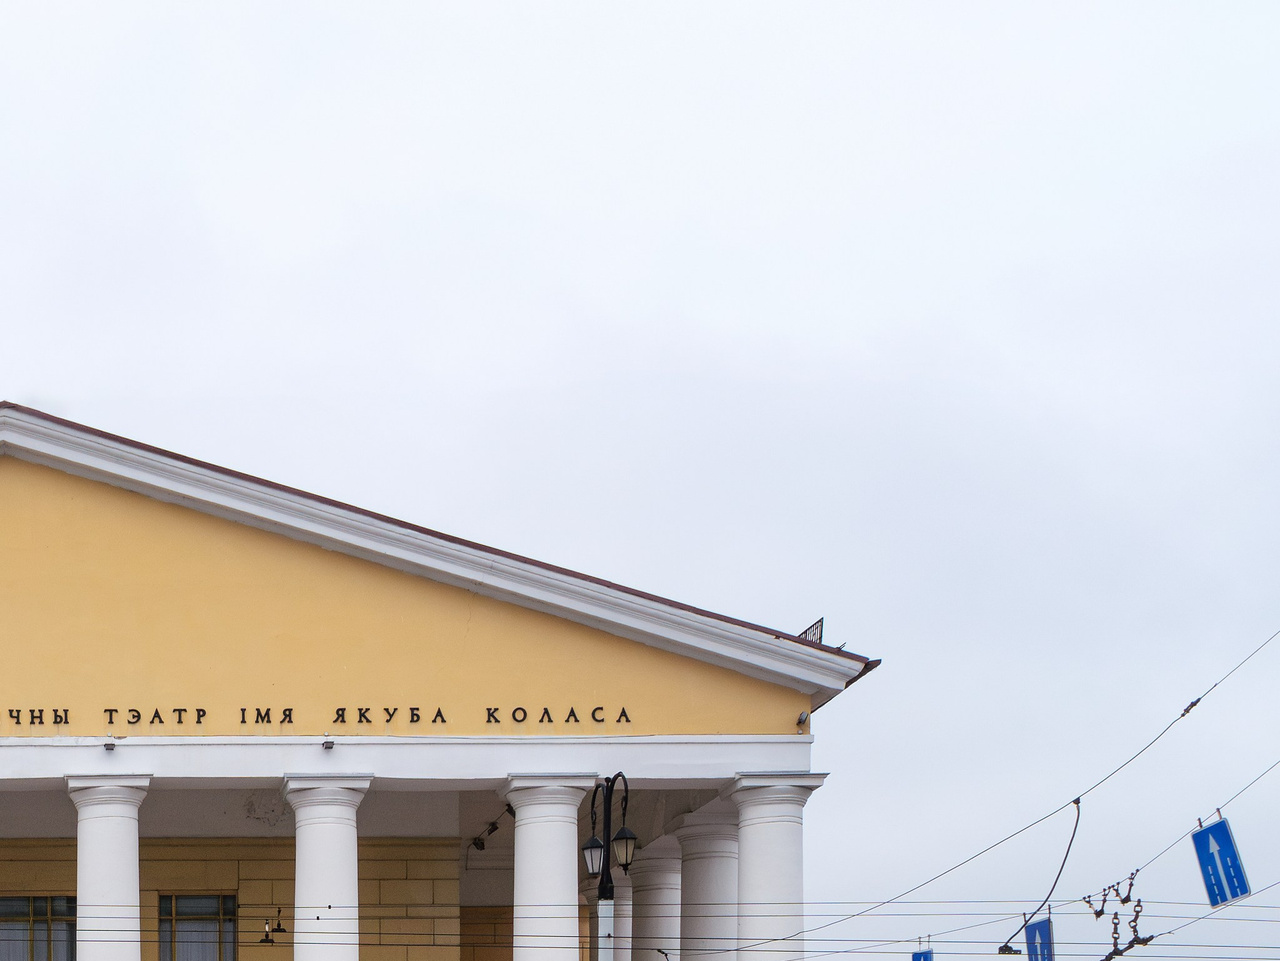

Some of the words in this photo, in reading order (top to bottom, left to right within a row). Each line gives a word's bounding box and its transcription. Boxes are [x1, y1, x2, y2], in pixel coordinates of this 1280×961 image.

[103, 708, 207, 725] ТЭАТР
[240, 707, 294, 724] ІМЯ
[332, 706, 447, 724] ЯКУБА
[485, 706, 631, 724] КОЛАСА
